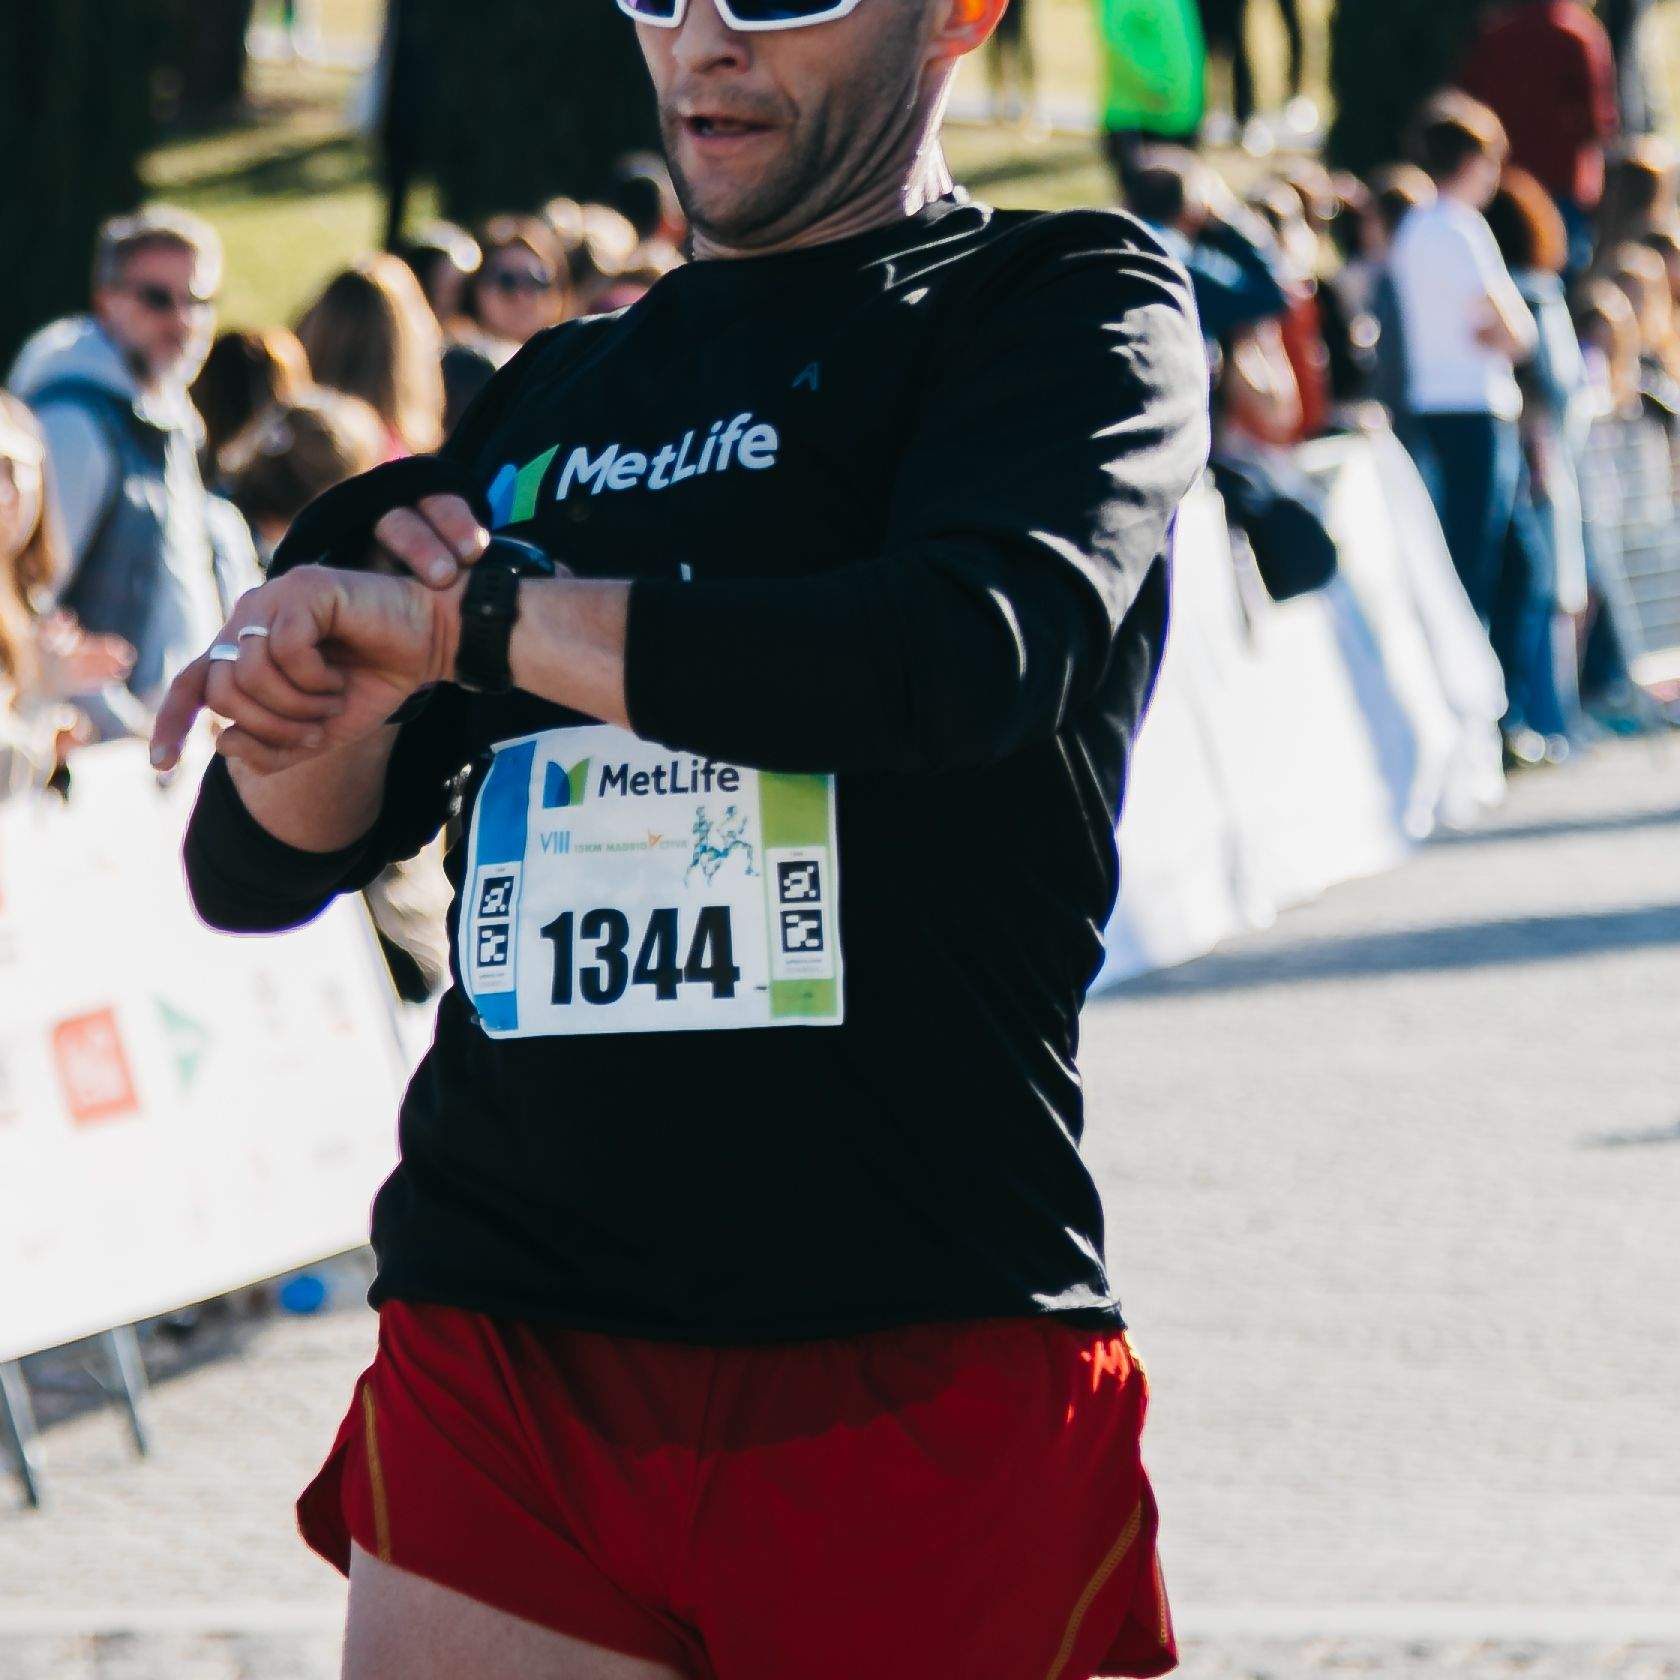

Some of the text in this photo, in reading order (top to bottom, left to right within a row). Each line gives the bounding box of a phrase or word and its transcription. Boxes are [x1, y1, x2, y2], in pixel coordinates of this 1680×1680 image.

[555, 412, 780, 502] MetLife
[598, 756, 741, 799] MetLife
[540, 830, 571, 855] VIII
[539, 905, 741, 1006] 1344
